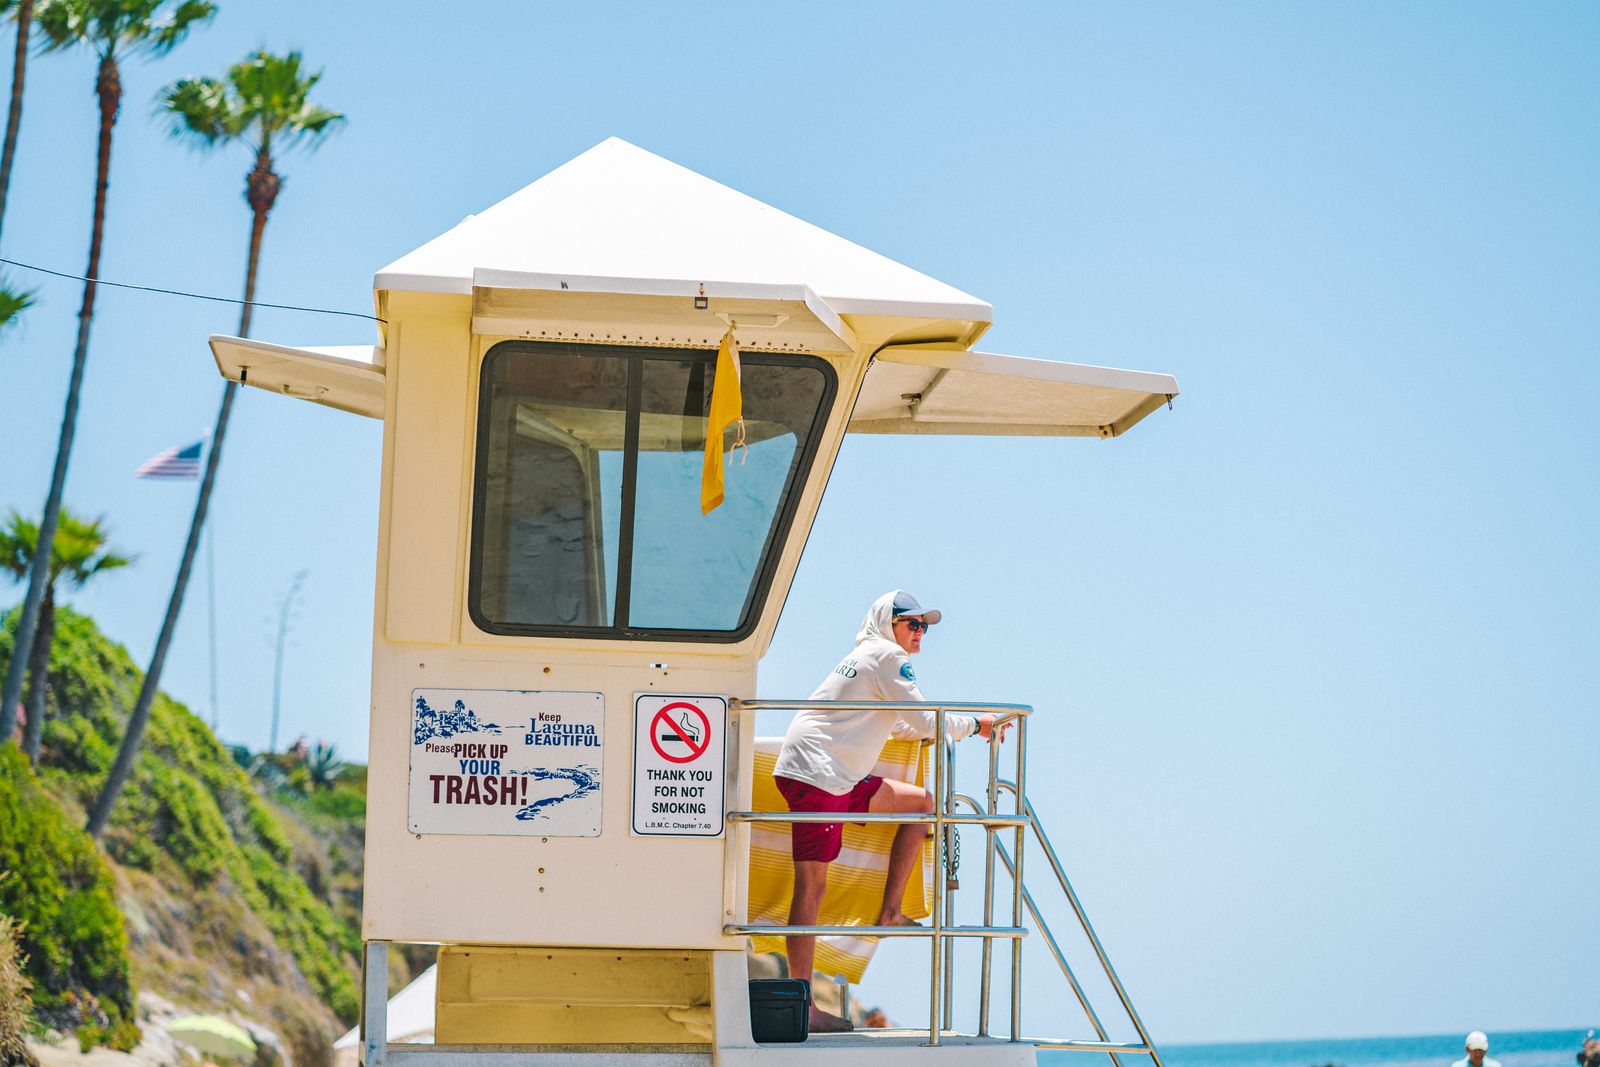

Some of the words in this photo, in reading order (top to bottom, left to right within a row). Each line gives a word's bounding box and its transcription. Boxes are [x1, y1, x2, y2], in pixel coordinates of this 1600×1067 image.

[538, 712, 561, 723] Keep
[529, 718, 595, 735] Laguna
[525, 734, 601, 747] BEAUTIFUL
[425, 743, 455, 753] Please
[454, 743, 486, 758] PICK
[490, 744, 508, 759] UP
[459, 759, 500, 775] YOUR
[646, 769, 686, 781] THANK
[689, 770, 713, 781] YOU
[429, 775, 528, 805] TRASH!
[654, 786, 678, 797] FOR
[681, 786, 705, 797] NOT
[651, 802, 706, 814] SMOKING
[672, 822, 697, 830] Chapter
